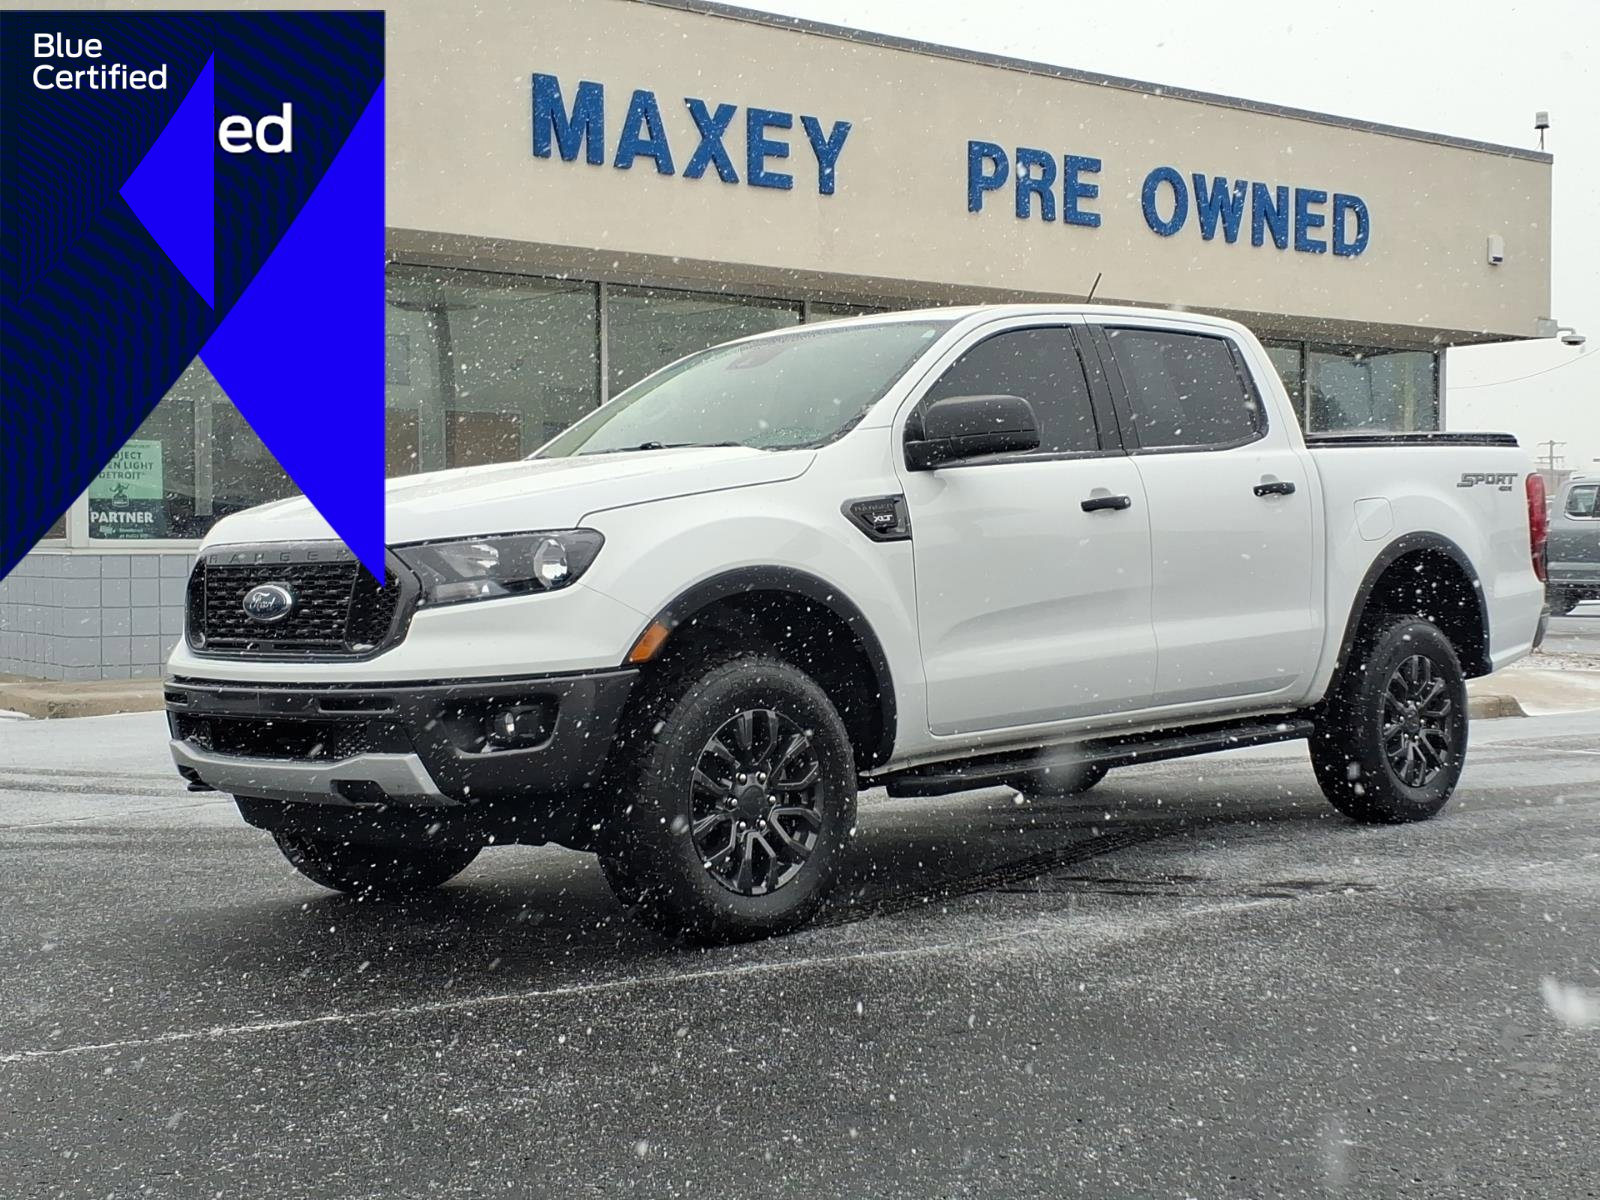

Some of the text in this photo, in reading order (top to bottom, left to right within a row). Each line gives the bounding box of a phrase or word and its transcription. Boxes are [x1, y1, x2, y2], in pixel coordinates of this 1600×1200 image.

[531, 72, 1370, 257] MAXEY PRE OWNED
[124, 461, 154, 470] LIGHT
[1456, 472, 1518, 488] SPORT
[90, 511, 154, 523] PARTNER
[873, 514, 893, 523] XLT
[208, 550, 350, 564] RANGER
[249, 592, 276, 610] Ford
